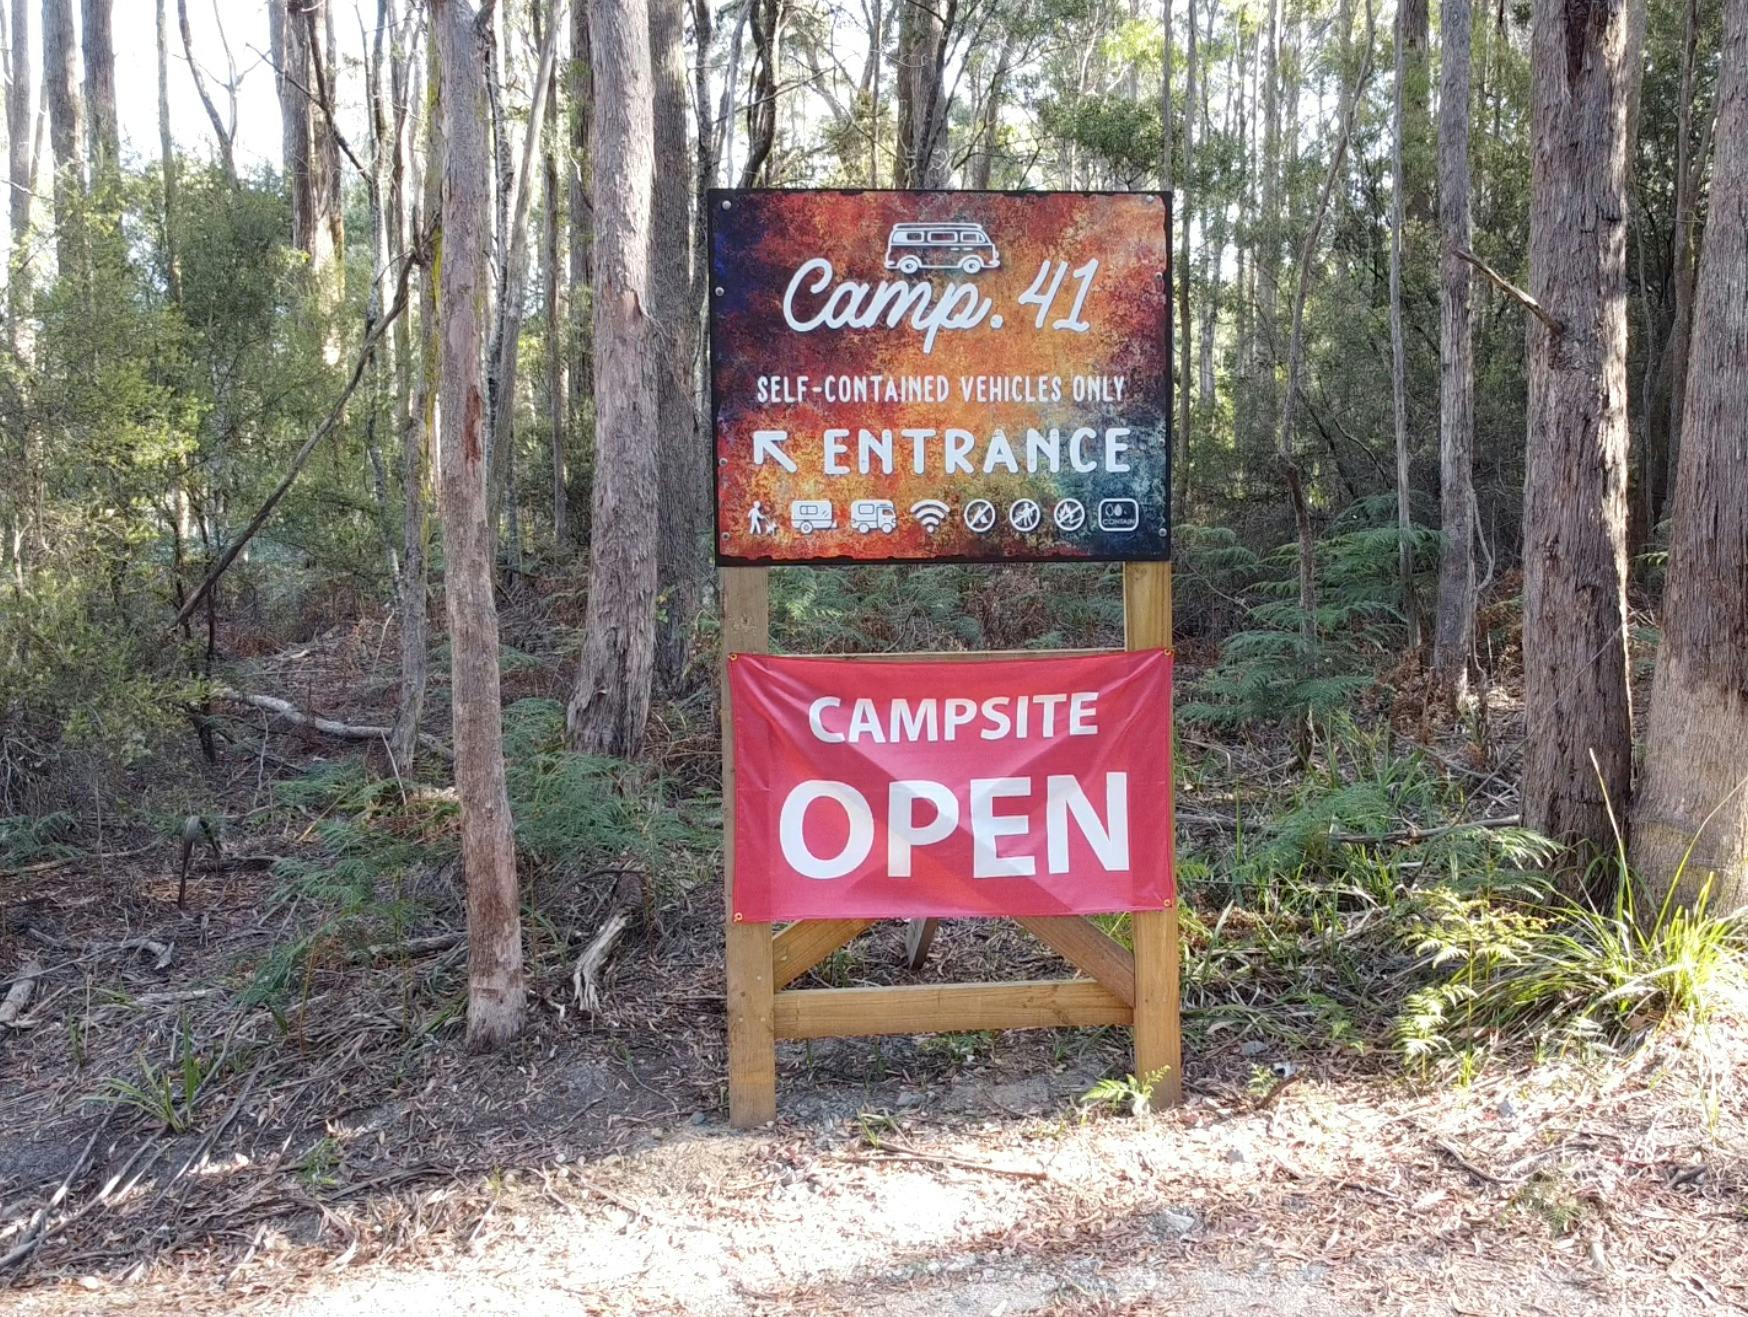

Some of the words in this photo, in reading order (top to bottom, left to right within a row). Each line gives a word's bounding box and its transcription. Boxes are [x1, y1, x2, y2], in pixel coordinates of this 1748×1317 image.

[783, 258, 1003, 353] Camp.
[1018, 257, 1100, 332] 41
[756, 375, 950, 403] SELF-CONTAINED
[960, 375, 1061, 403] VEHICLES
[1073, 375, 1126, 403] ONLY
[823, 428, 1132, 475] ENTRANCE
[808, 692, 1099, 744] CAMPSITE
[779, 771, 1130, 880] OPEN
